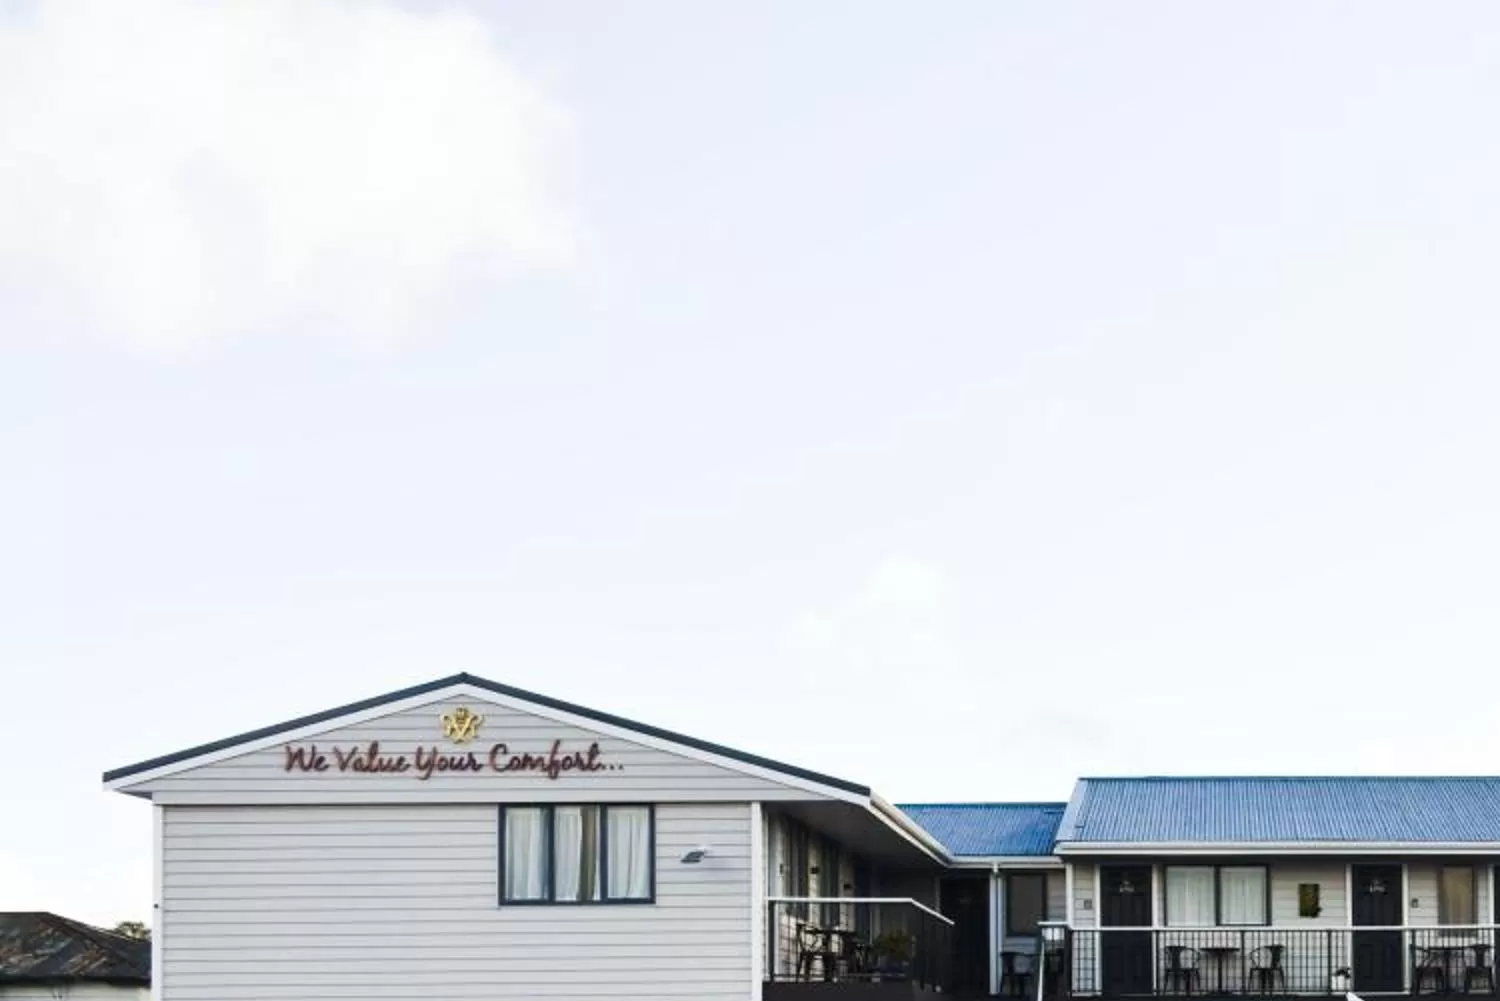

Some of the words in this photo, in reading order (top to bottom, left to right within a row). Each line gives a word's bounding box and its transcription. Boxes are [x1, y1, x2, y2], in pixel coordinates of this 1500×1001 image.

[284, 743, 329, 772] We
[332, 739, 411, 774] Value
[414, 745, 483, 780] Your
